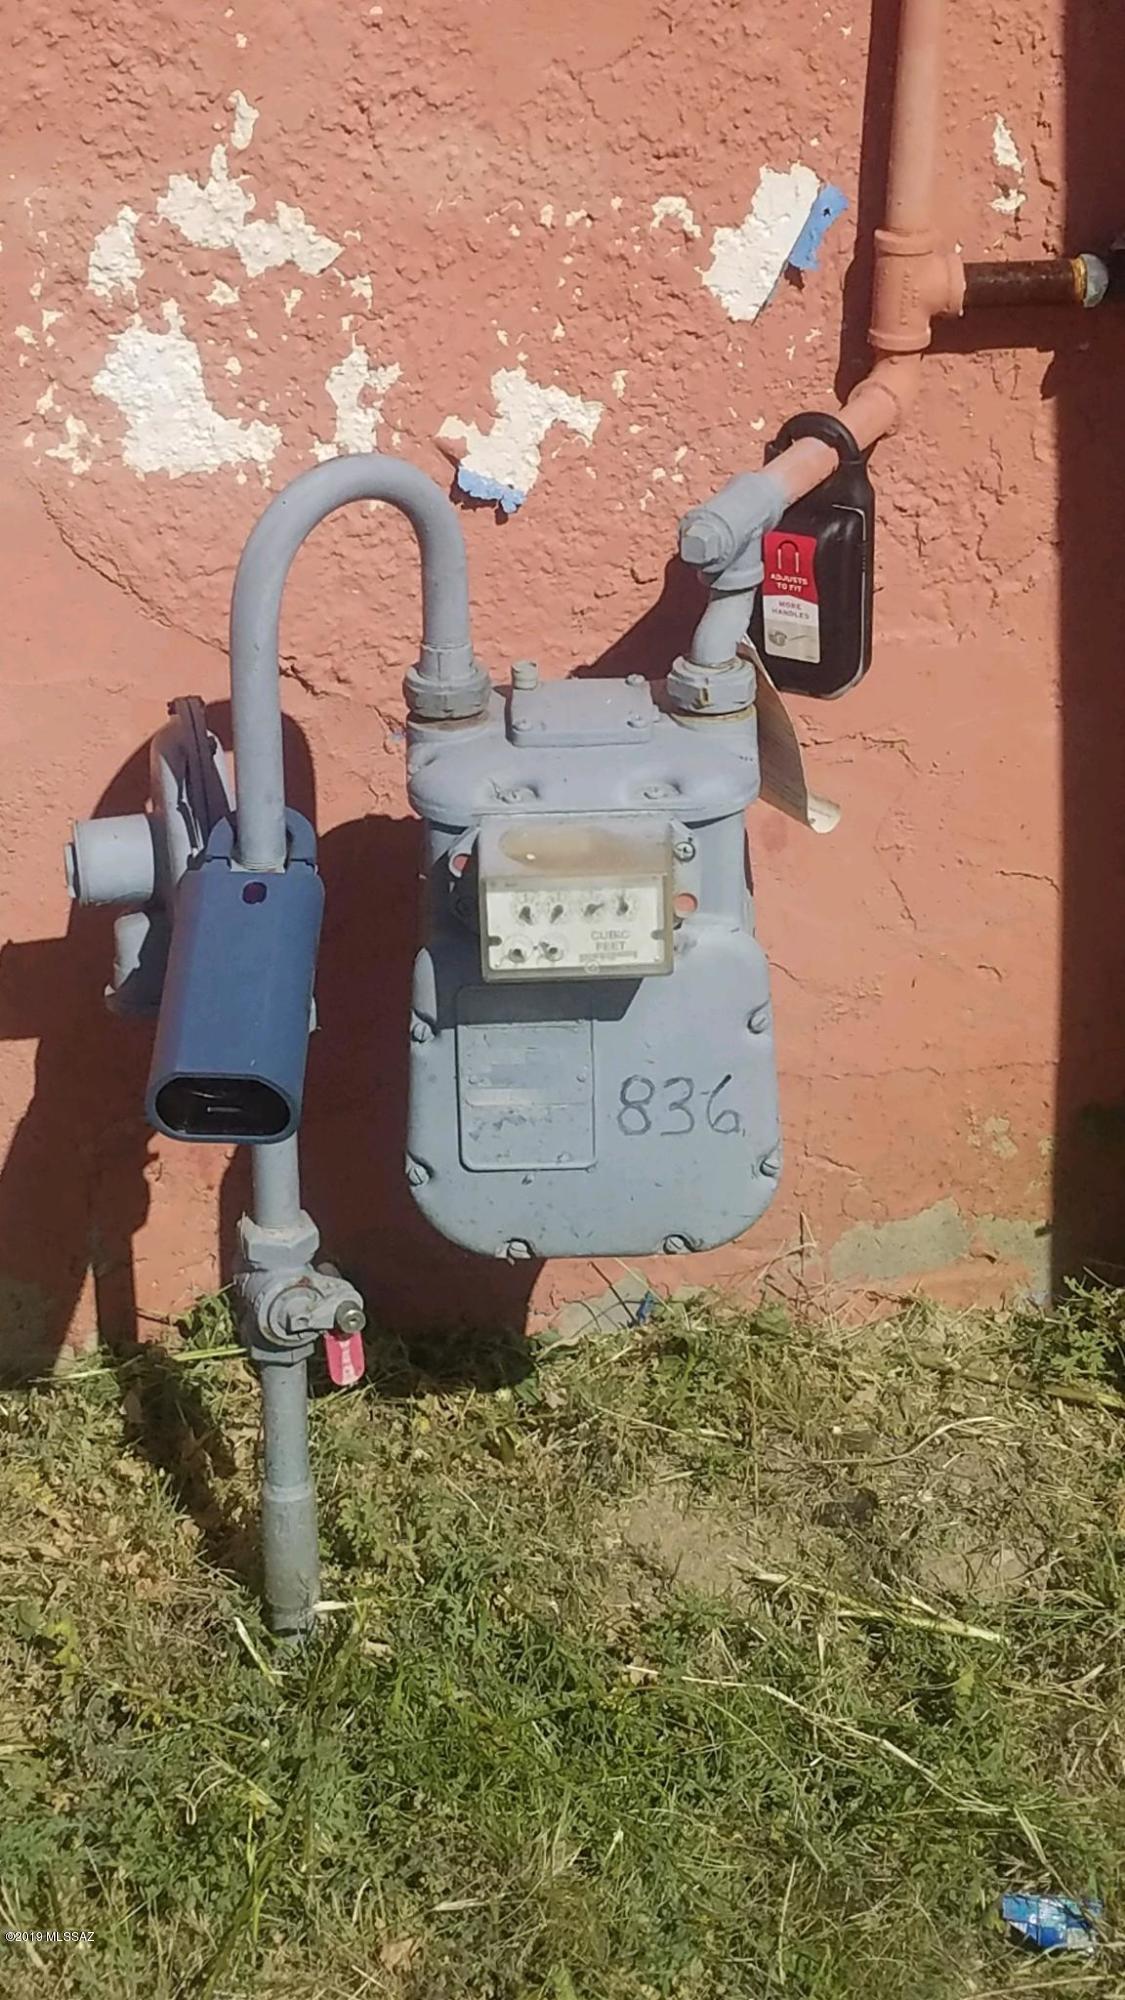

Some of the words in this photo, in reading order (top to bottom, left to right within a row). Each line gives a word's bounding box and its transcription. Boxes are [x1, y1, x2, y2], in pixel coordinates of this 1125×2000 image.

[770, 573, 809, 585] ADJUSTS
[776, 581, 788, 591] TO
[789, 583, 802, 593] FIT
[779, 601, 802, 610] MORE
[772, 607, 810, 619] HANDLES
[590, 929, 631, 940] CUBIC
[595, 940, 626, 951] FEET
[616, 1073, 741, 1136] 836
